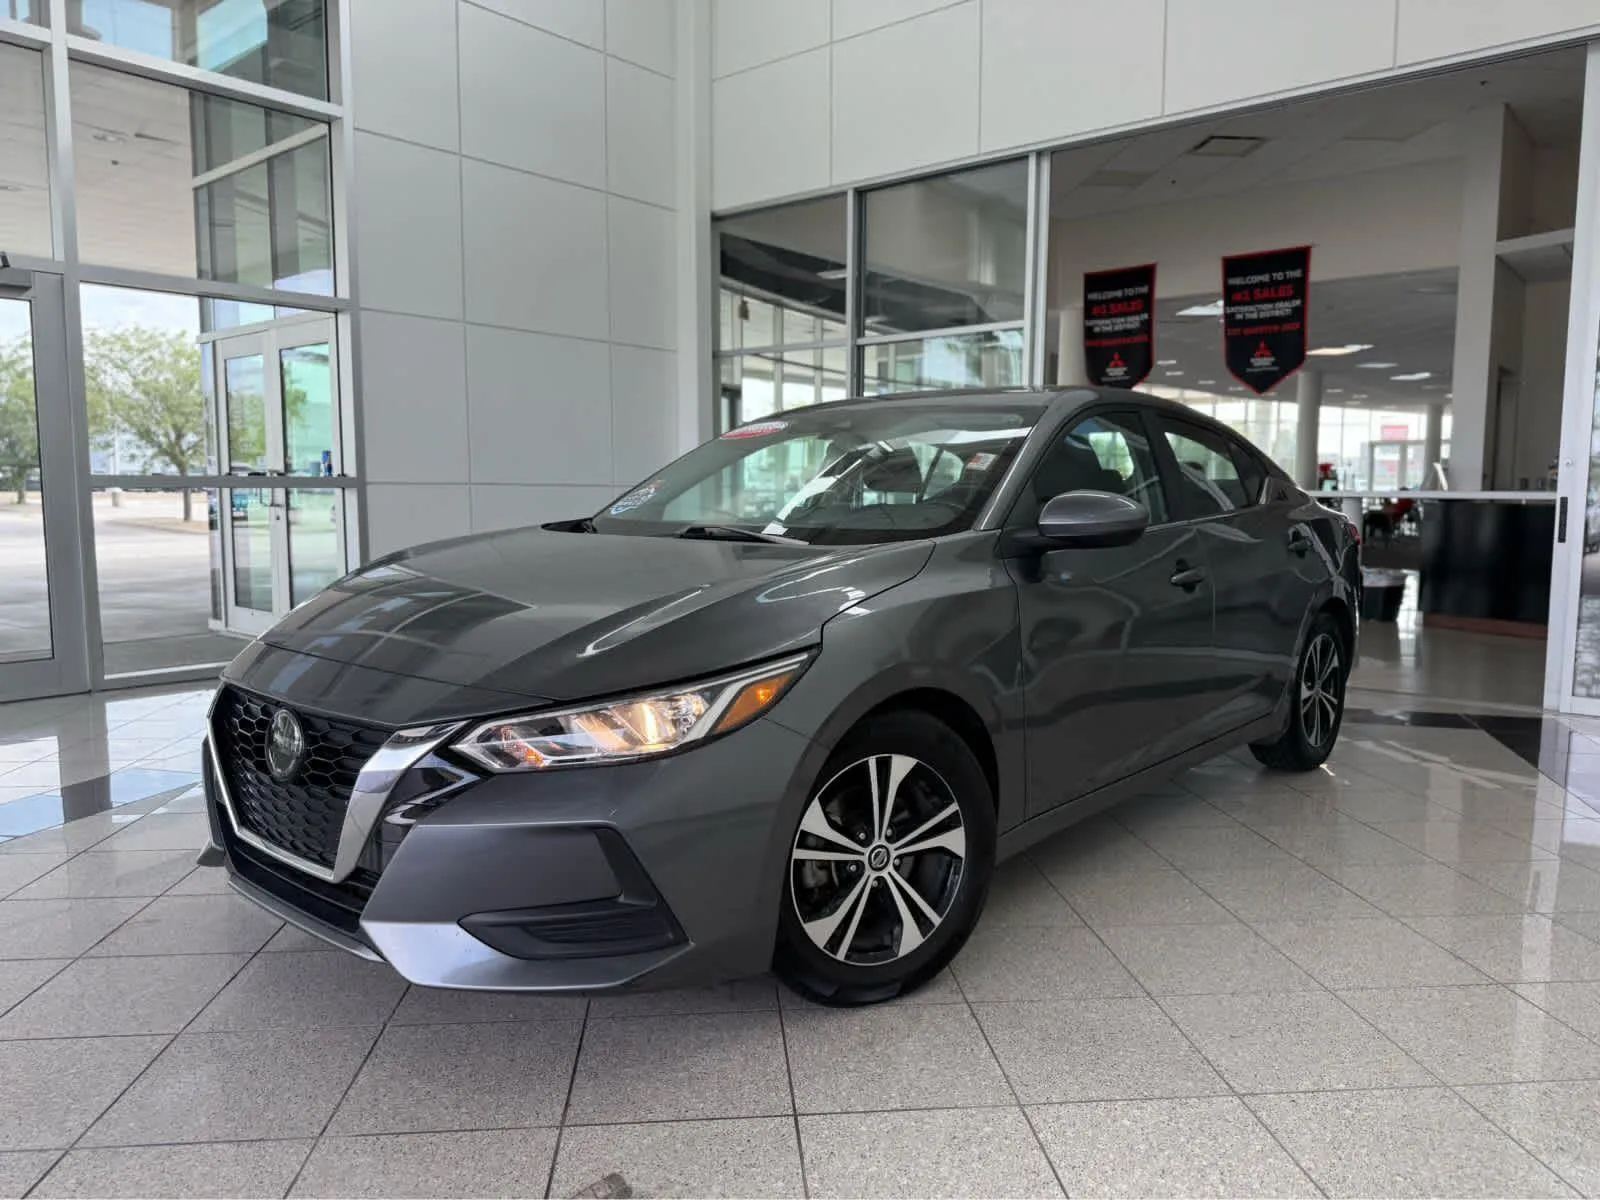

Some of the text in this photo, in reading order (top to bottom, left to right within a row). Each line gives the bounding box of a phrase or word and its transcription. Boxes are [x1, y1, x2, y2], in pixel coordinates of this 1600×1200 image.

[1227, 269, 1303, 285] WELCOME TO THE
[1253, 284, 1294, 300] SALES
